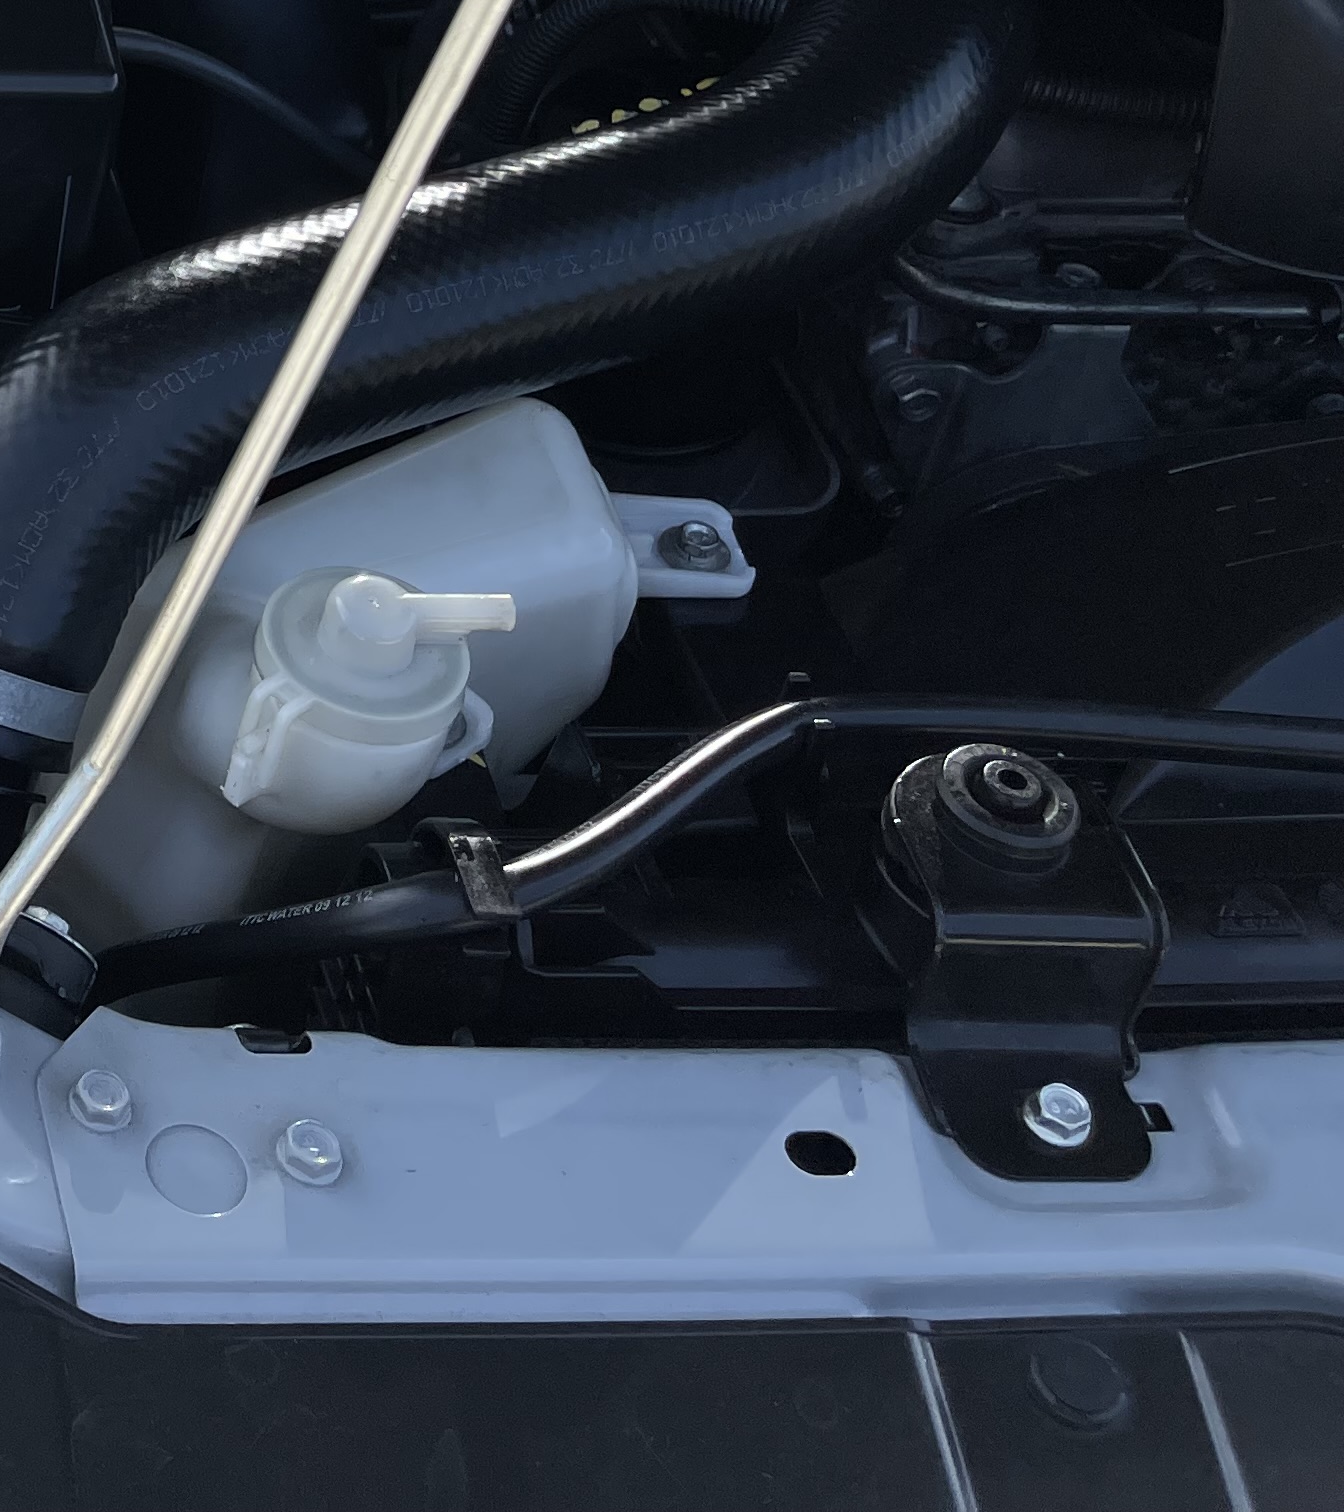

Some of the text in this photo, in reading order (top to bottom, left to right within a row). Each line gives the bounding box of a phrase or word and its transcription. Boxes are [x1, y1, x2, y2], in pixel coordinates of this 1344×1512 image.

[267, 904, 312, 921] WATER
[314, 899, 331, 912] 09
[335, 895, 351, 908] 12
[355, 890, 373, 903] 12
